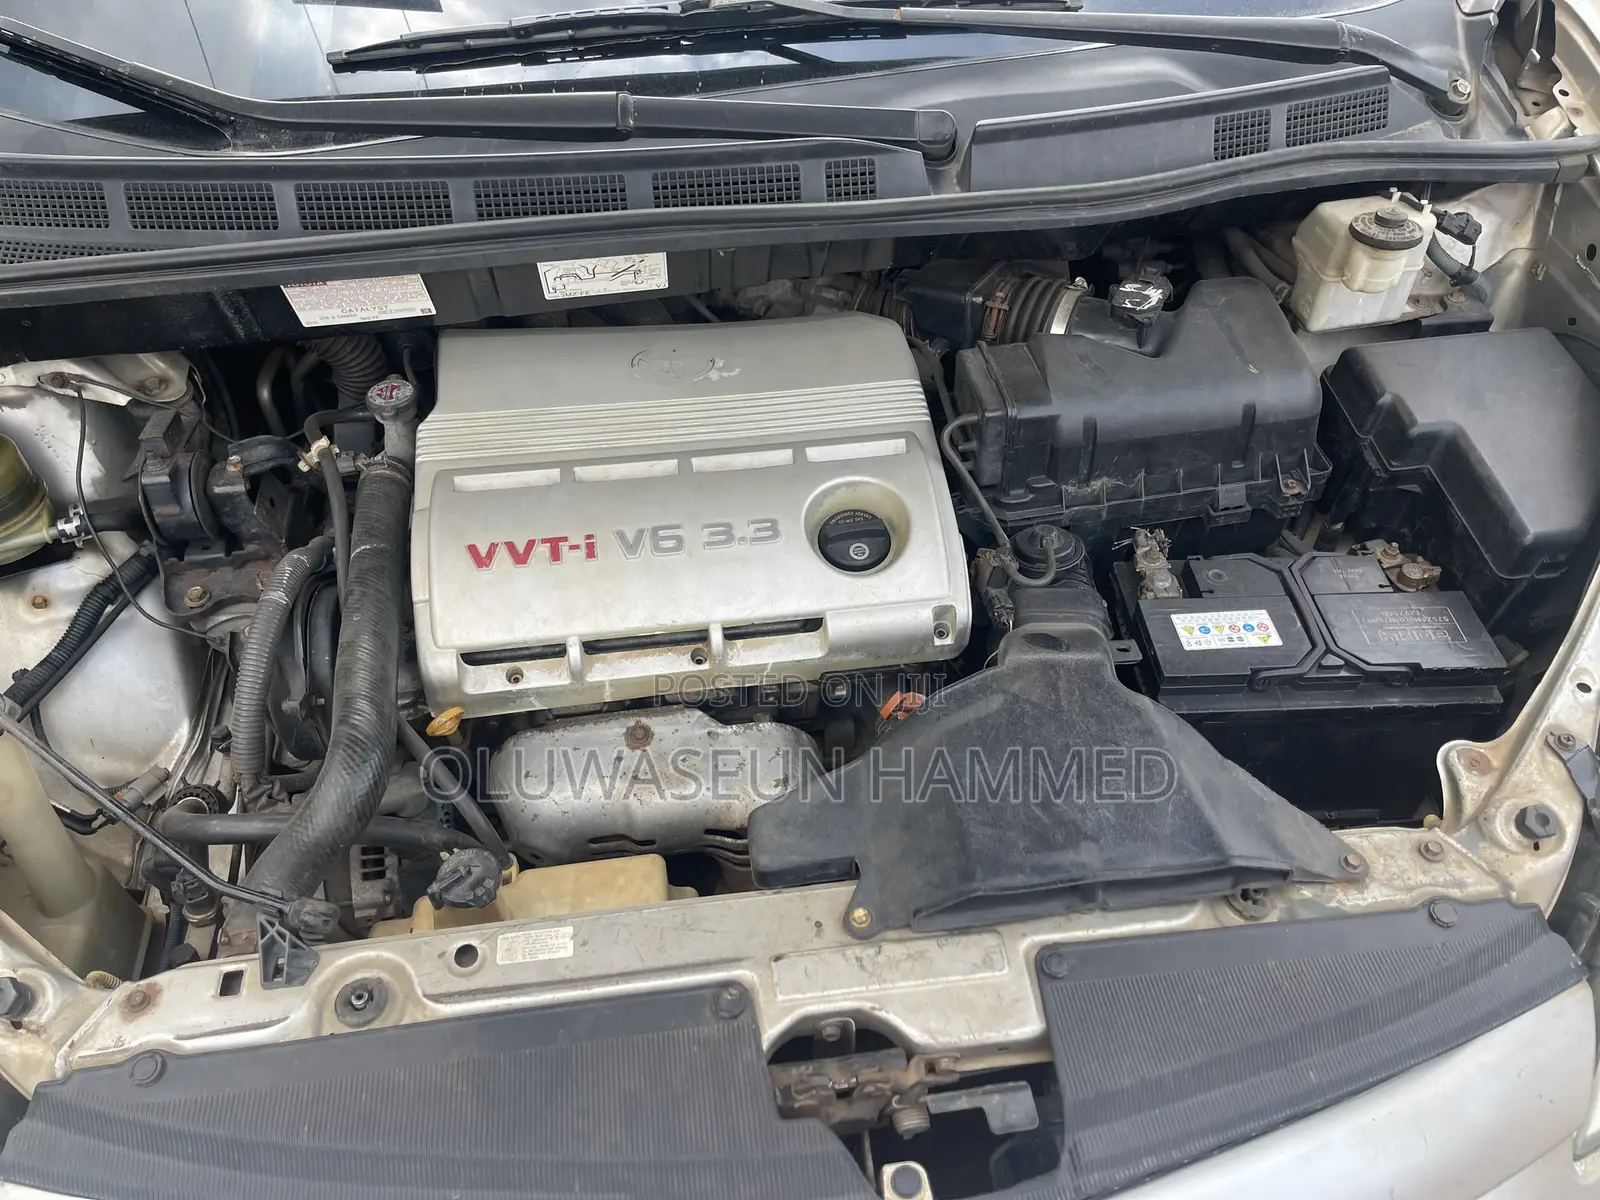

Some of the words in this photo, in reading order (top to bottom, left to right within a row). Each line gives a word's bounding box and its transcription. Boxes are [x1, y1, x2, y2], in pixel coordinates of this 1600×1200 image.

[340, 304, 390, 314] CATALYST
[465, 533, 599, 572] VVT-i
[613, 523, 685, 561] V6
[702, 517, 783, 550] 3.3
